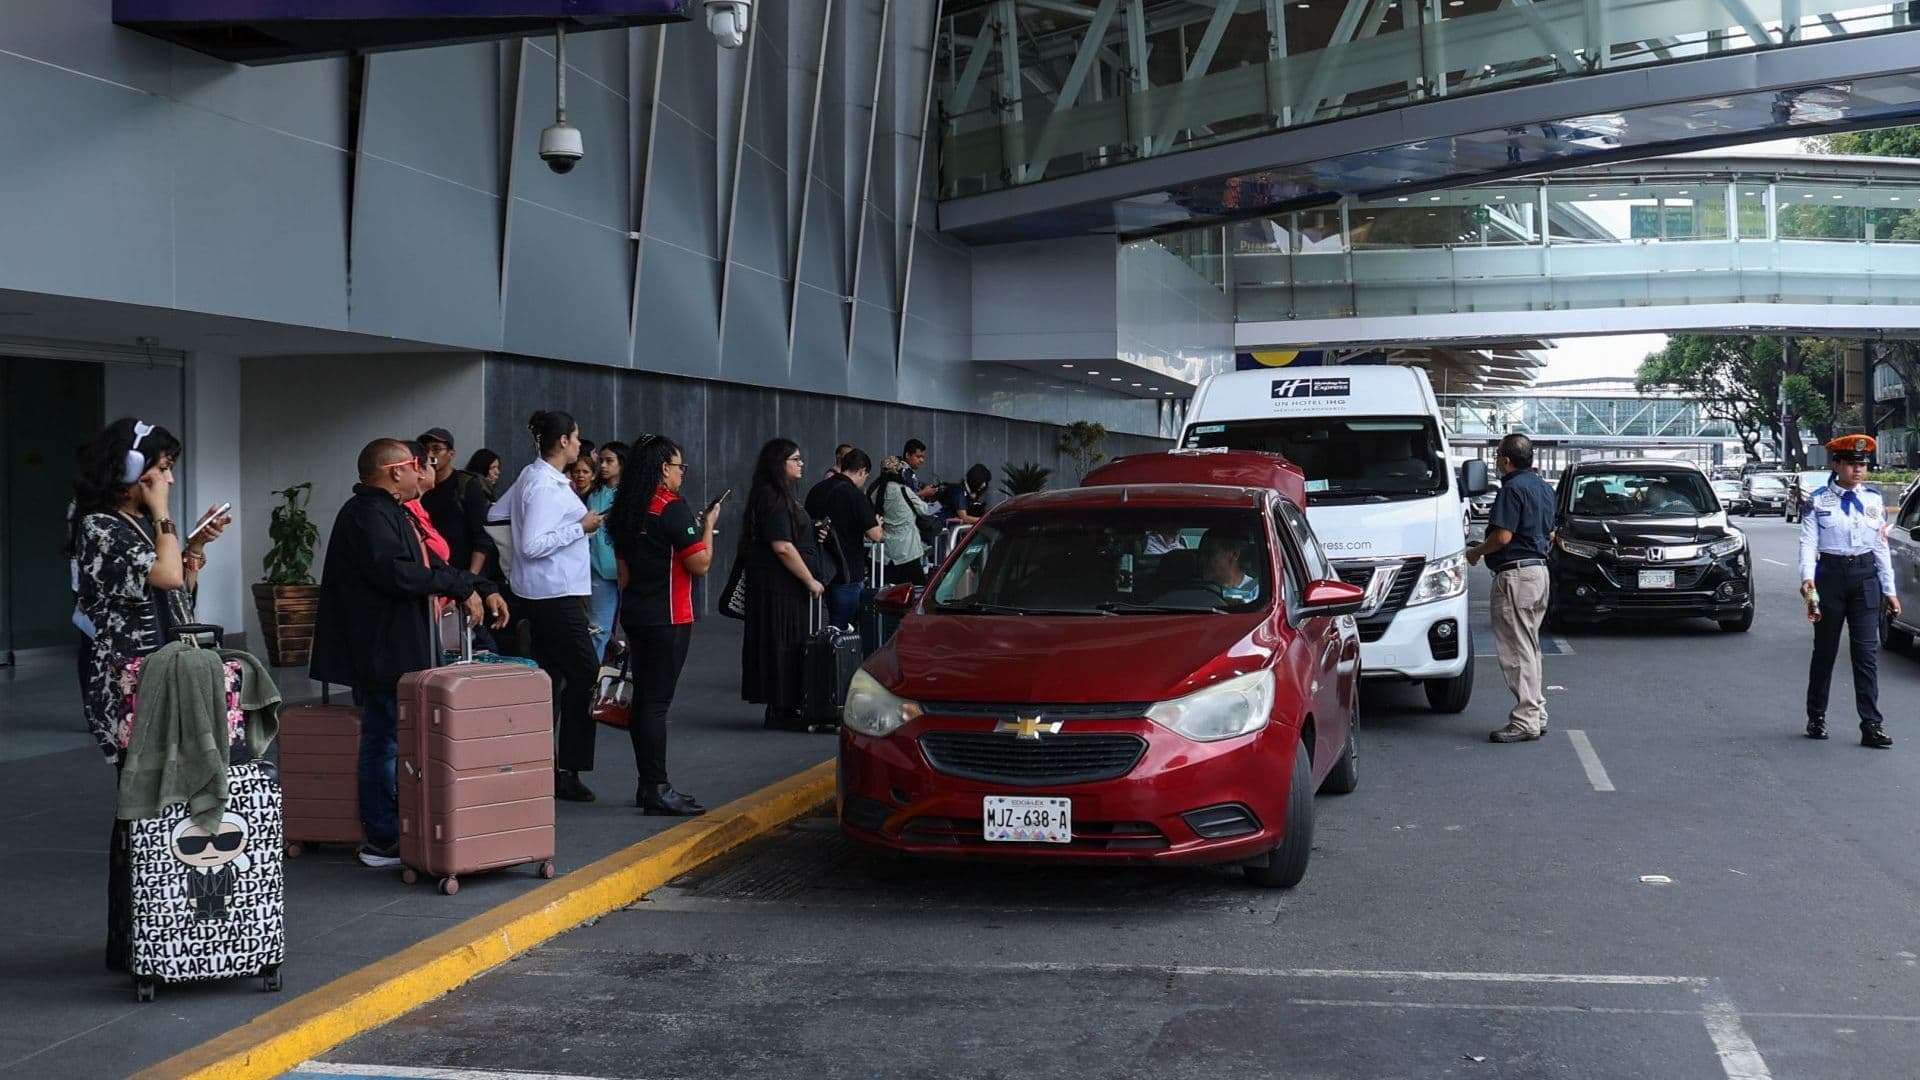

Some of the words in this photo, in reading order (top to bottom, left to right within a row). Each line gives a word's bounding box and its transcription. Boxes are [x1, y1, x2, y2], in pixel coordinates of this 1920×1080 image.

[987, 808, 1067, 829] MJZ-638-A
[131, 835, 169, 849] KARL
[218, 921, 262, 941] PARIS
[134, 942, 172, 959] KARL
[172, 935, 259, 958] LAGERFELD
[135, 958, 176, 976] PARIS
[176, 956, 215, 975] KARL
